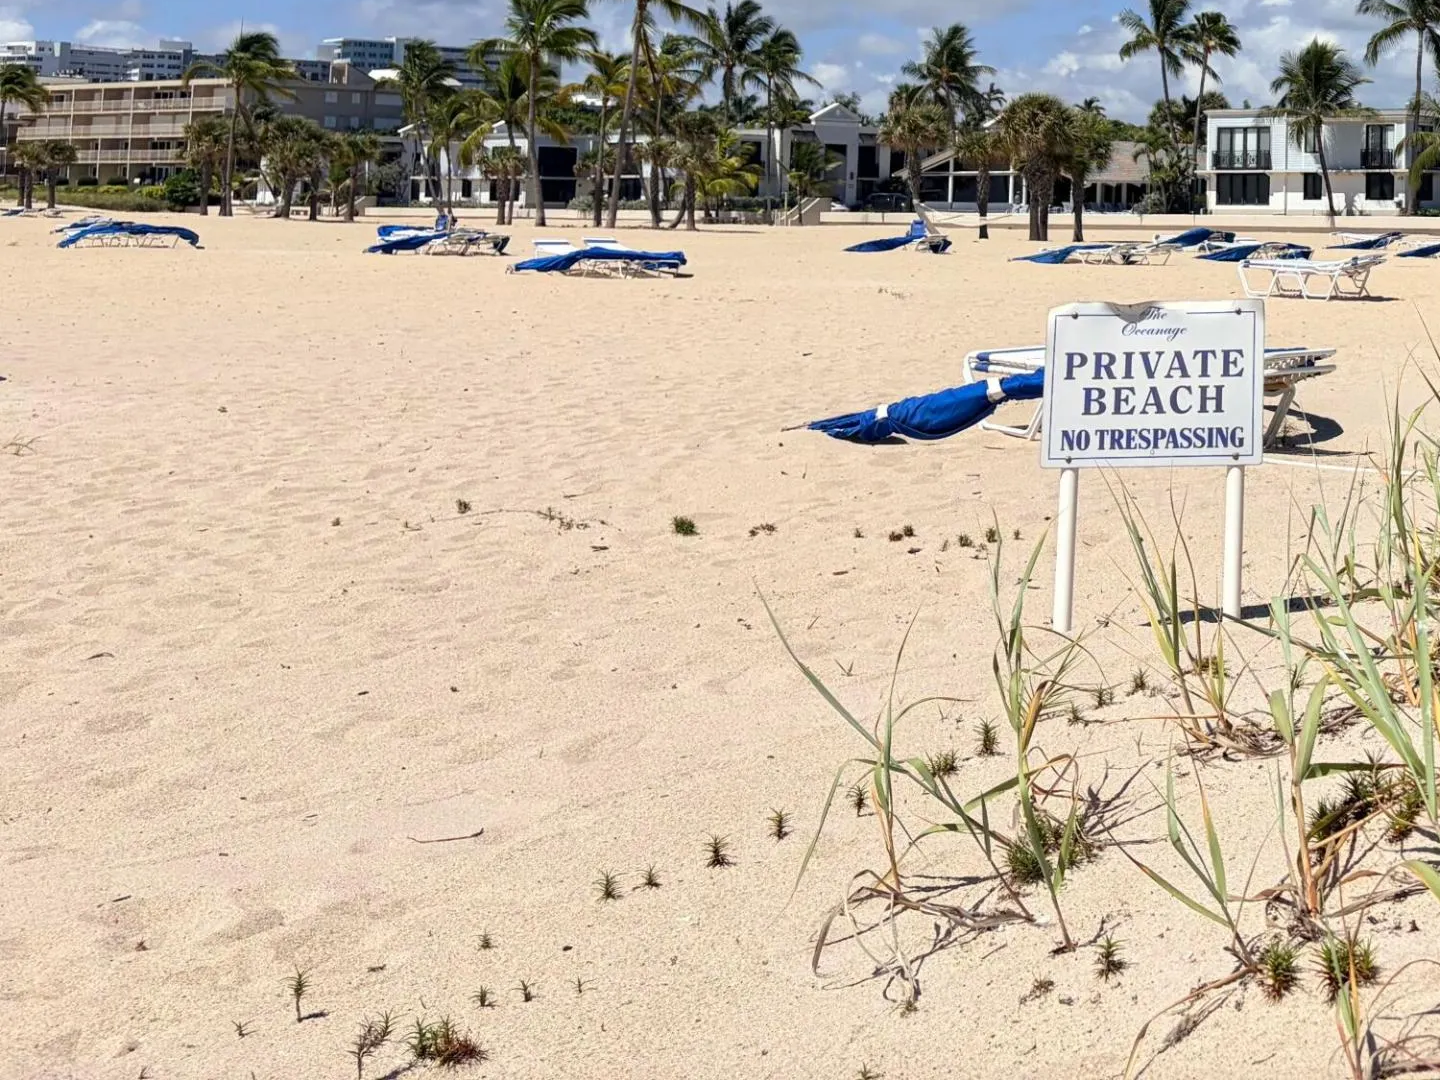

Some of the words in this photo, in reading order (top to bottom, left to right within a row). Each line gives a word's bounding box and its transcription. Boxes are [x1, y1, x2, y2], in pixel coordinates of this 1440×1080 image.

[1139, 305, 1168, 321] The
[1063, 349, 1245, 381] PRIVATE
[1081, 384, 1226, 416] BEACH
[1060, 429, 1091, 451] NO
[1095, 426, 1245, 451] TRESPASSING
